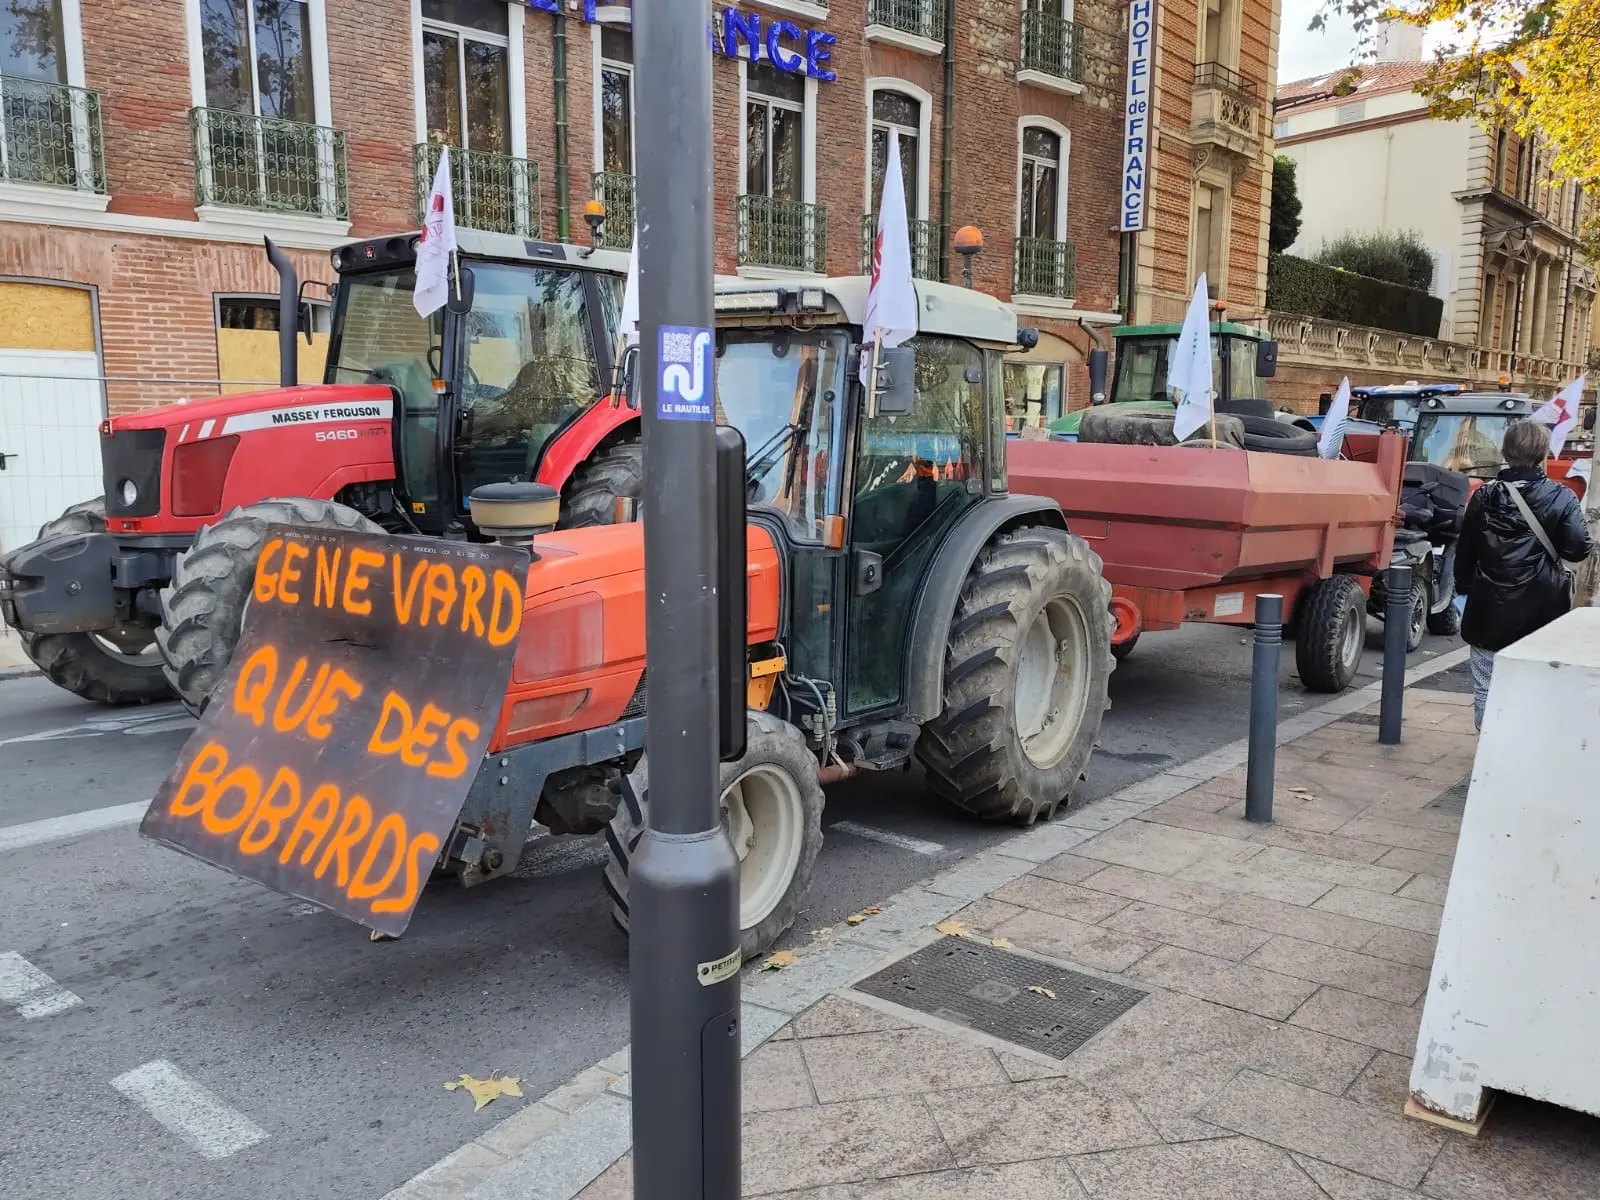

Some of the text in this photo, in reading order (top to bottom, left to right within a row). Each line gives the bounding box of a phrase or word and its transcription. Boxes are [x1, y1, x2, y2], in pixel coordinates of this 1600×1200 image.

[1124, 1, 1150, 228] HOTEL de FRANCE
[271, 406, 381, 424] MASSEY FERGUSON
[315, 429, 358, 442] 5460
[662, 404, 711, 414] LE NAUTILUS
[254, 538, 523, 646] GENEVARD
[233, 645, 480, 779] QUE DES
[169, 741, 440, 914] BOBARDS
